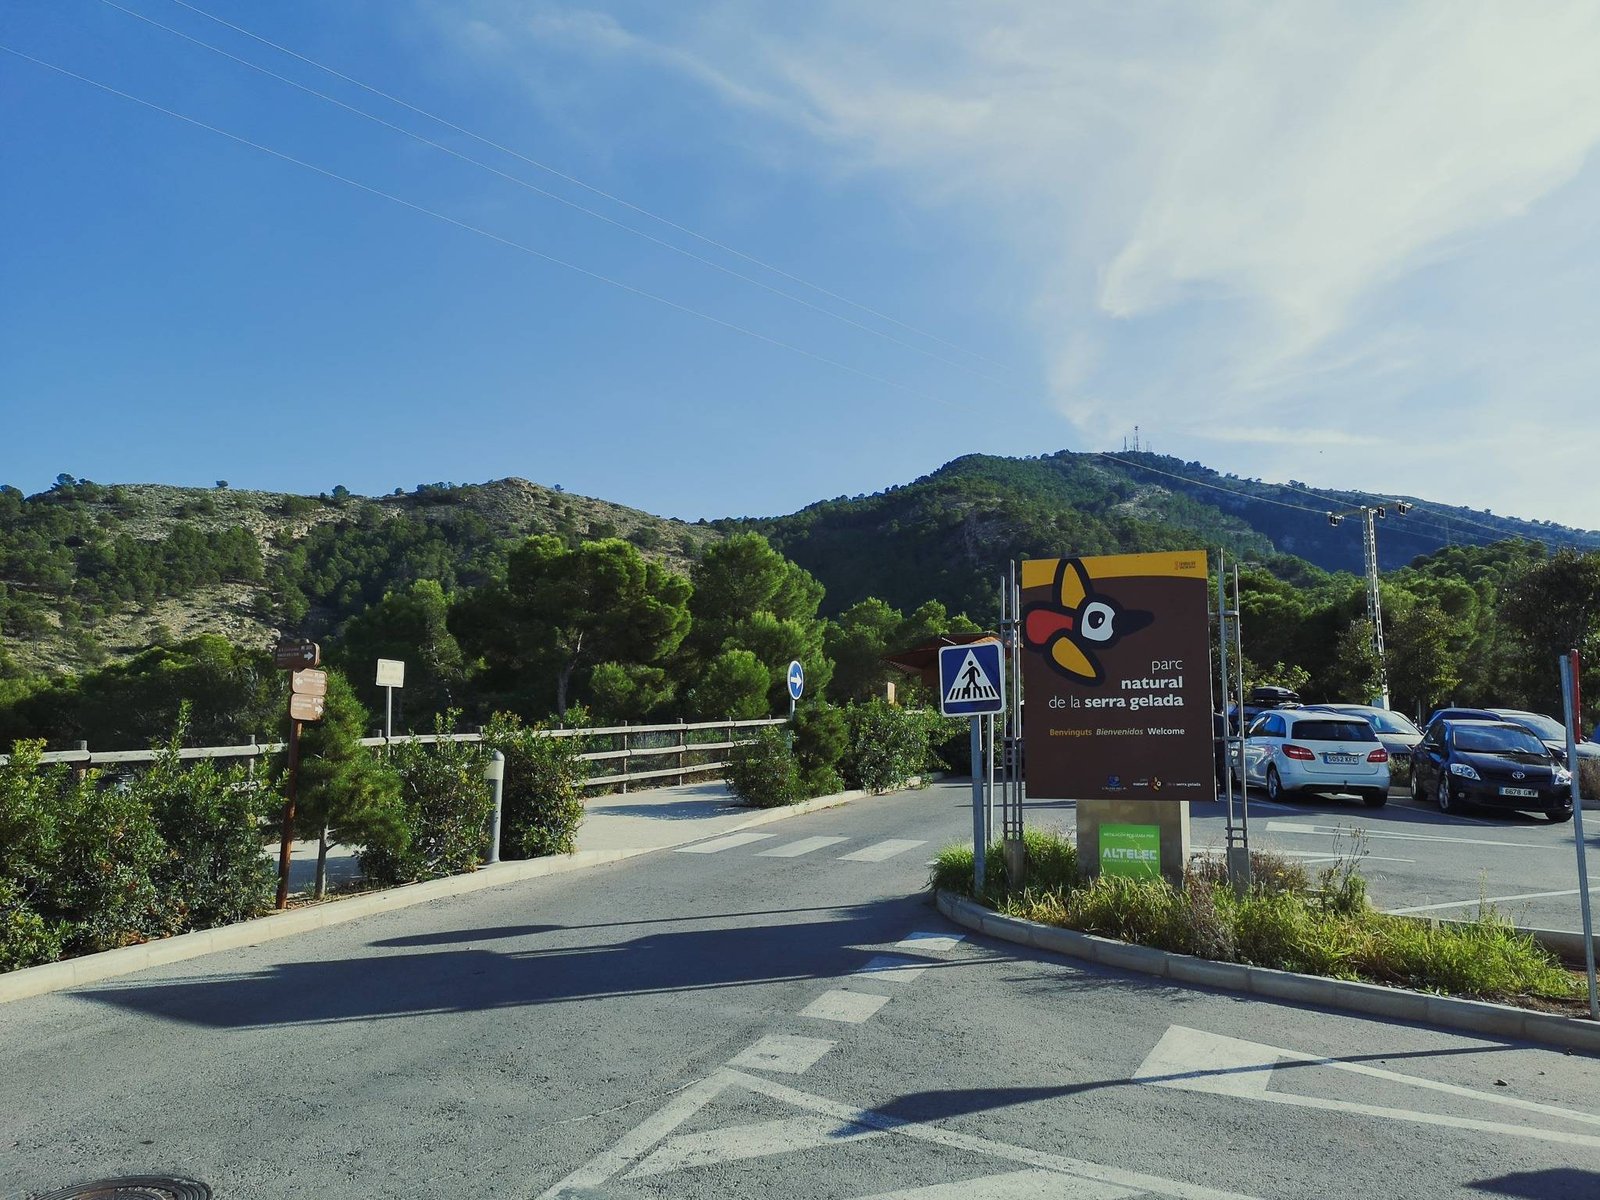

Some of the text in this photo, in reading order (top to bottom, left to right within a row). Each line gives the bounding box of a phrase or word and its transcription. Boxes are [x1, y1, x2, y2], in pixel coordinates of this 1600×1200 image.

[1151, 659, 1184, 674] parc
[1121, 676, 1184, 690] natural
[1048, 694, 1184, 711] de la serra gelada
[1049, 727, 1186, 738] Benvinguts Bienvenidos Welcome
